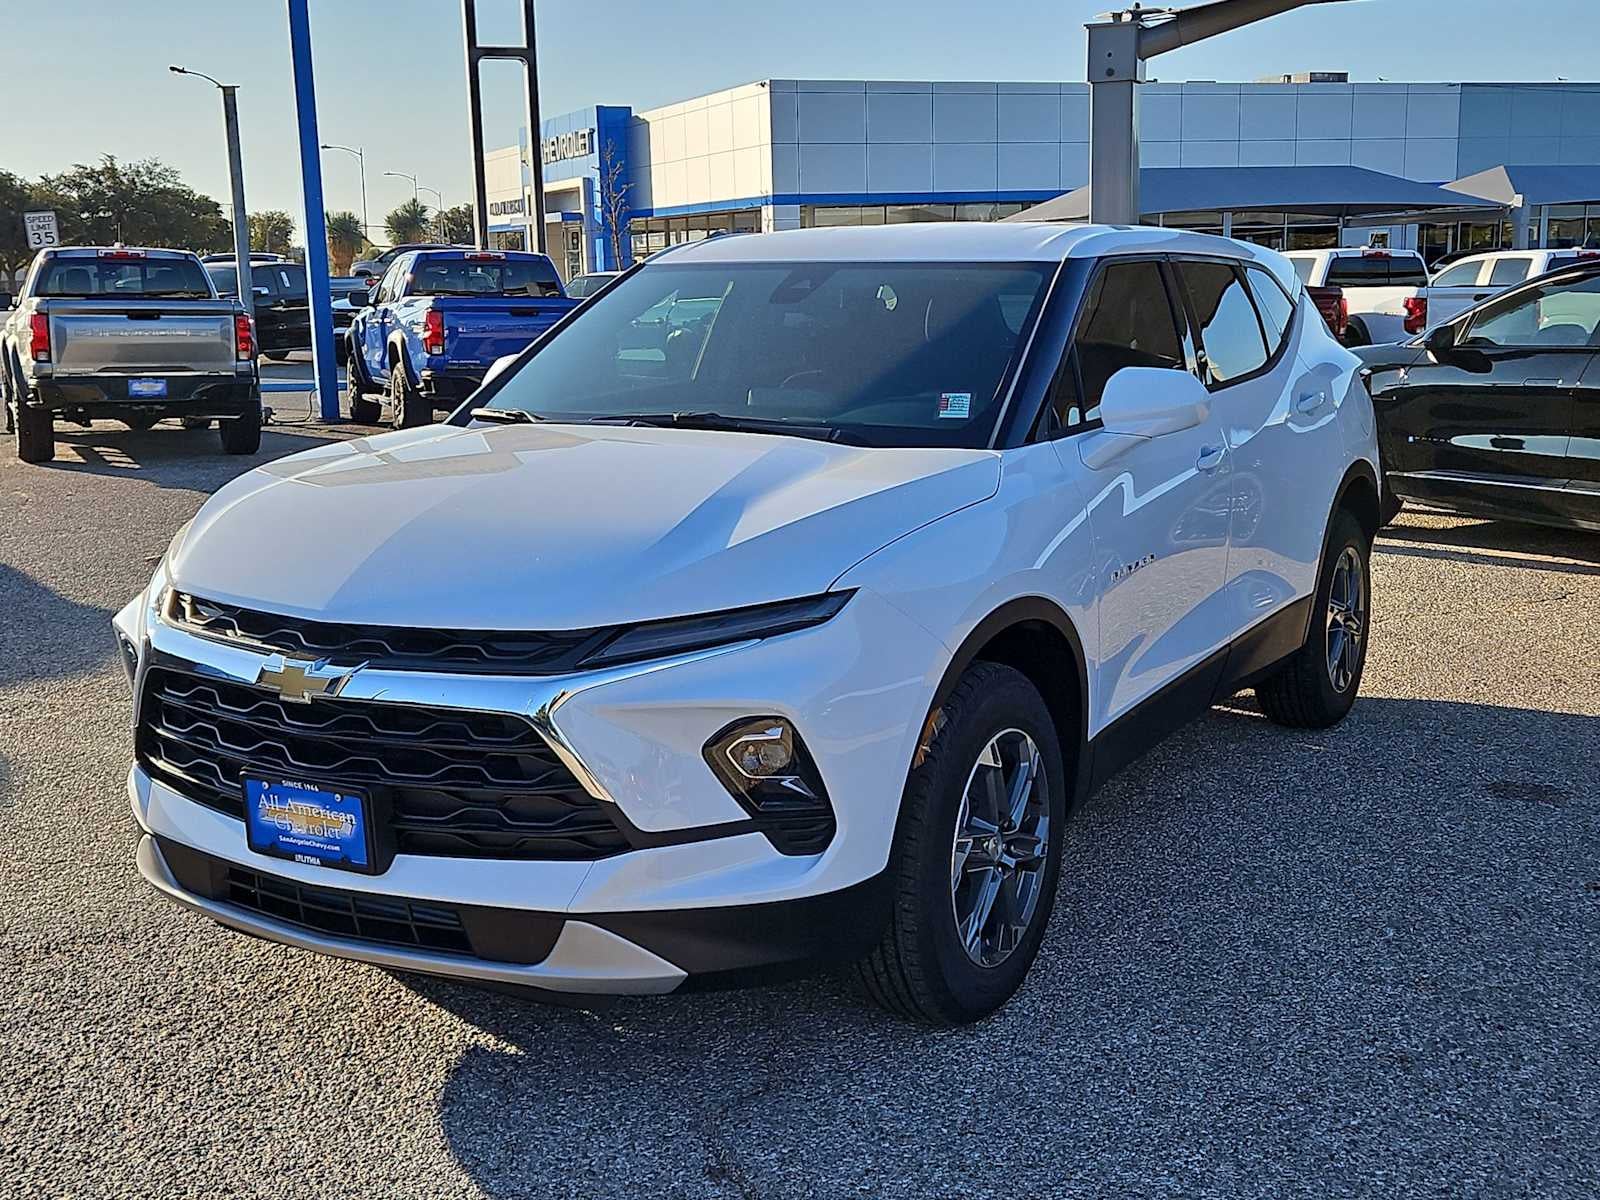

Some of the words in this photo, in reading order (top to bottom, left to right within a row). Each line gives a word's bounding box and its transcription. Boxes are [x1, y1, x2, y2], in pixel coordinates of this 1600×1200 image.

[541, 128, 595, 164] HEVROLET
[26, 215, 54, 224] SPEED
[31, 223, 50, 231] LIMIT
[31, 231, 55, 245] 35
[281, 780, 303, 790] SINCE
[258, 794, 280, 811] All
[283, 798, 357, 825] American
[274, 812, 342, 839] Chevrolet
[278, 834, 341, 851] SanAngeloChevy.com
